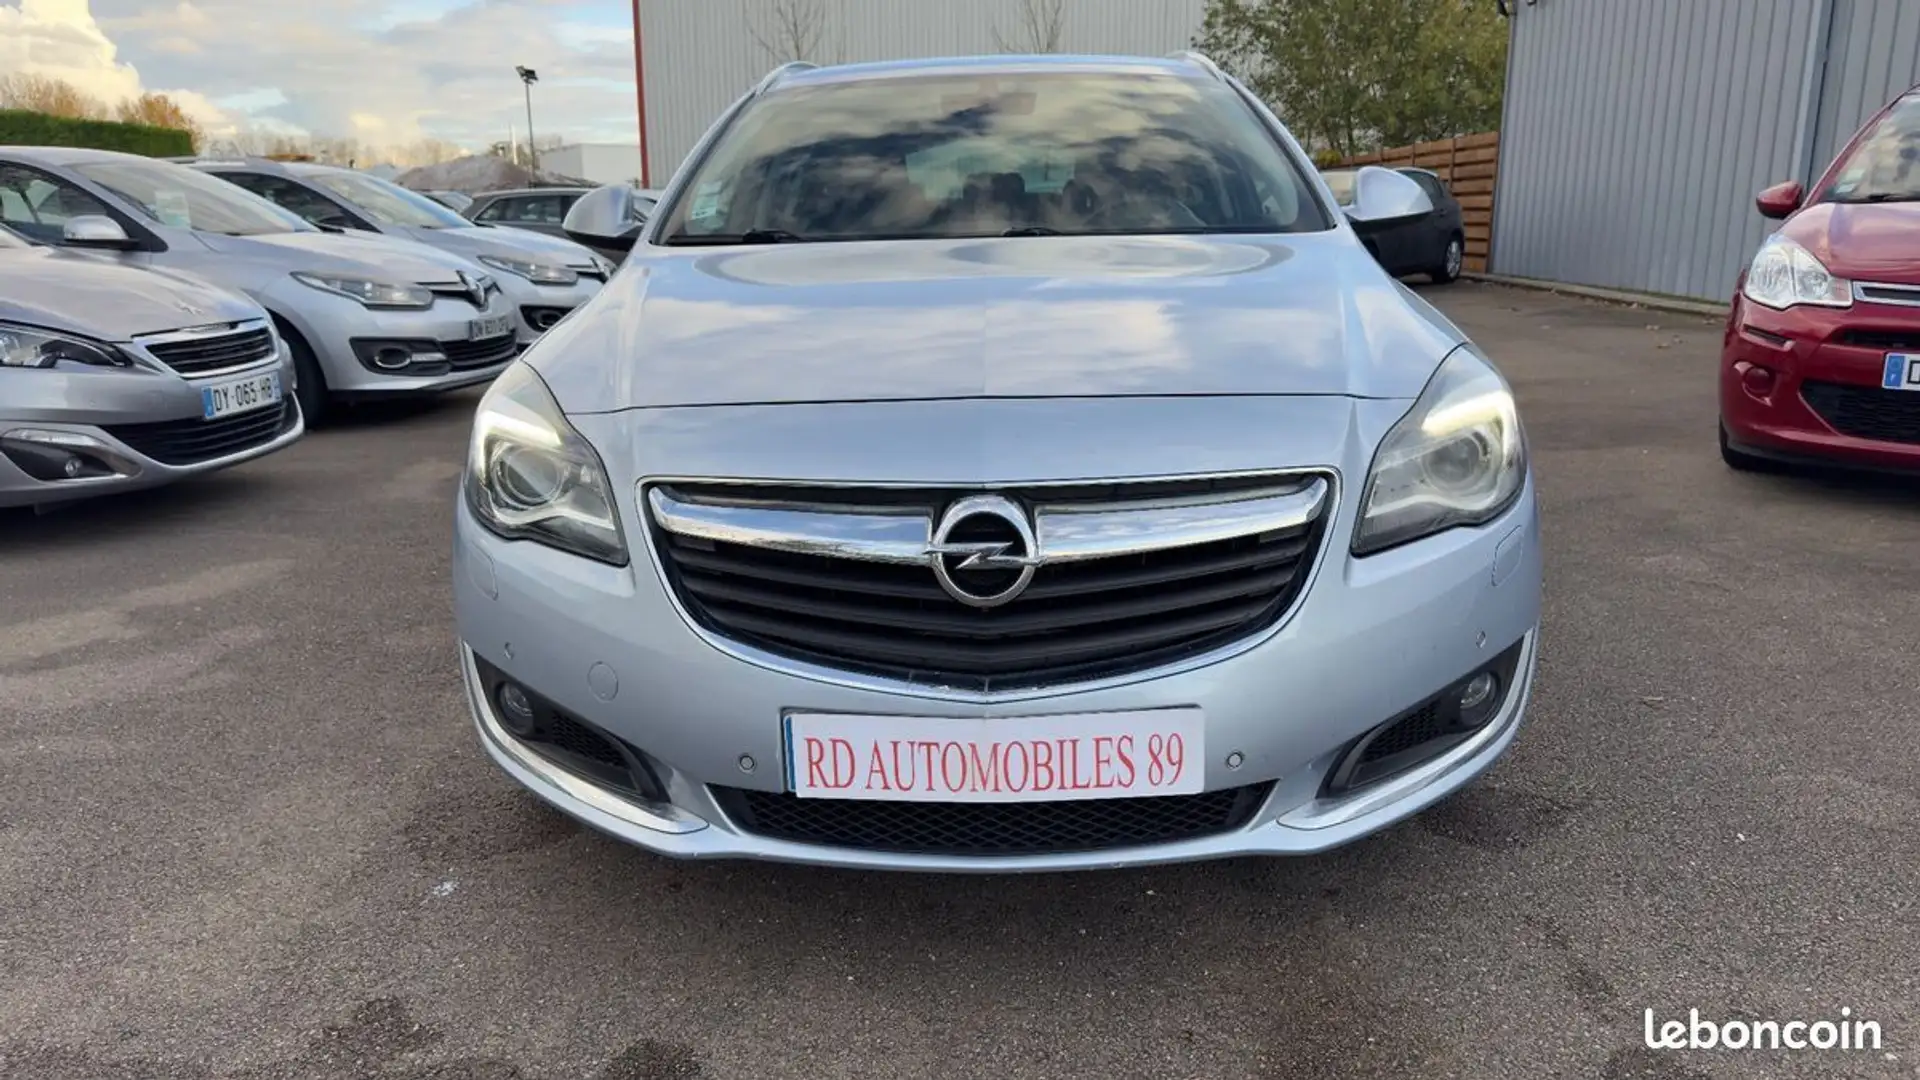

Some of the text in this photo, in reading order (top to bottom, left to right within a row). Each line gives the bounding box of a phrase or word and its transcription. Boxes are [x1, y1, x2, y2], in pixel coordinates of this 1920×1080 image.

[805, 732, 1184, 793] RD AUTOMOBILES 89
